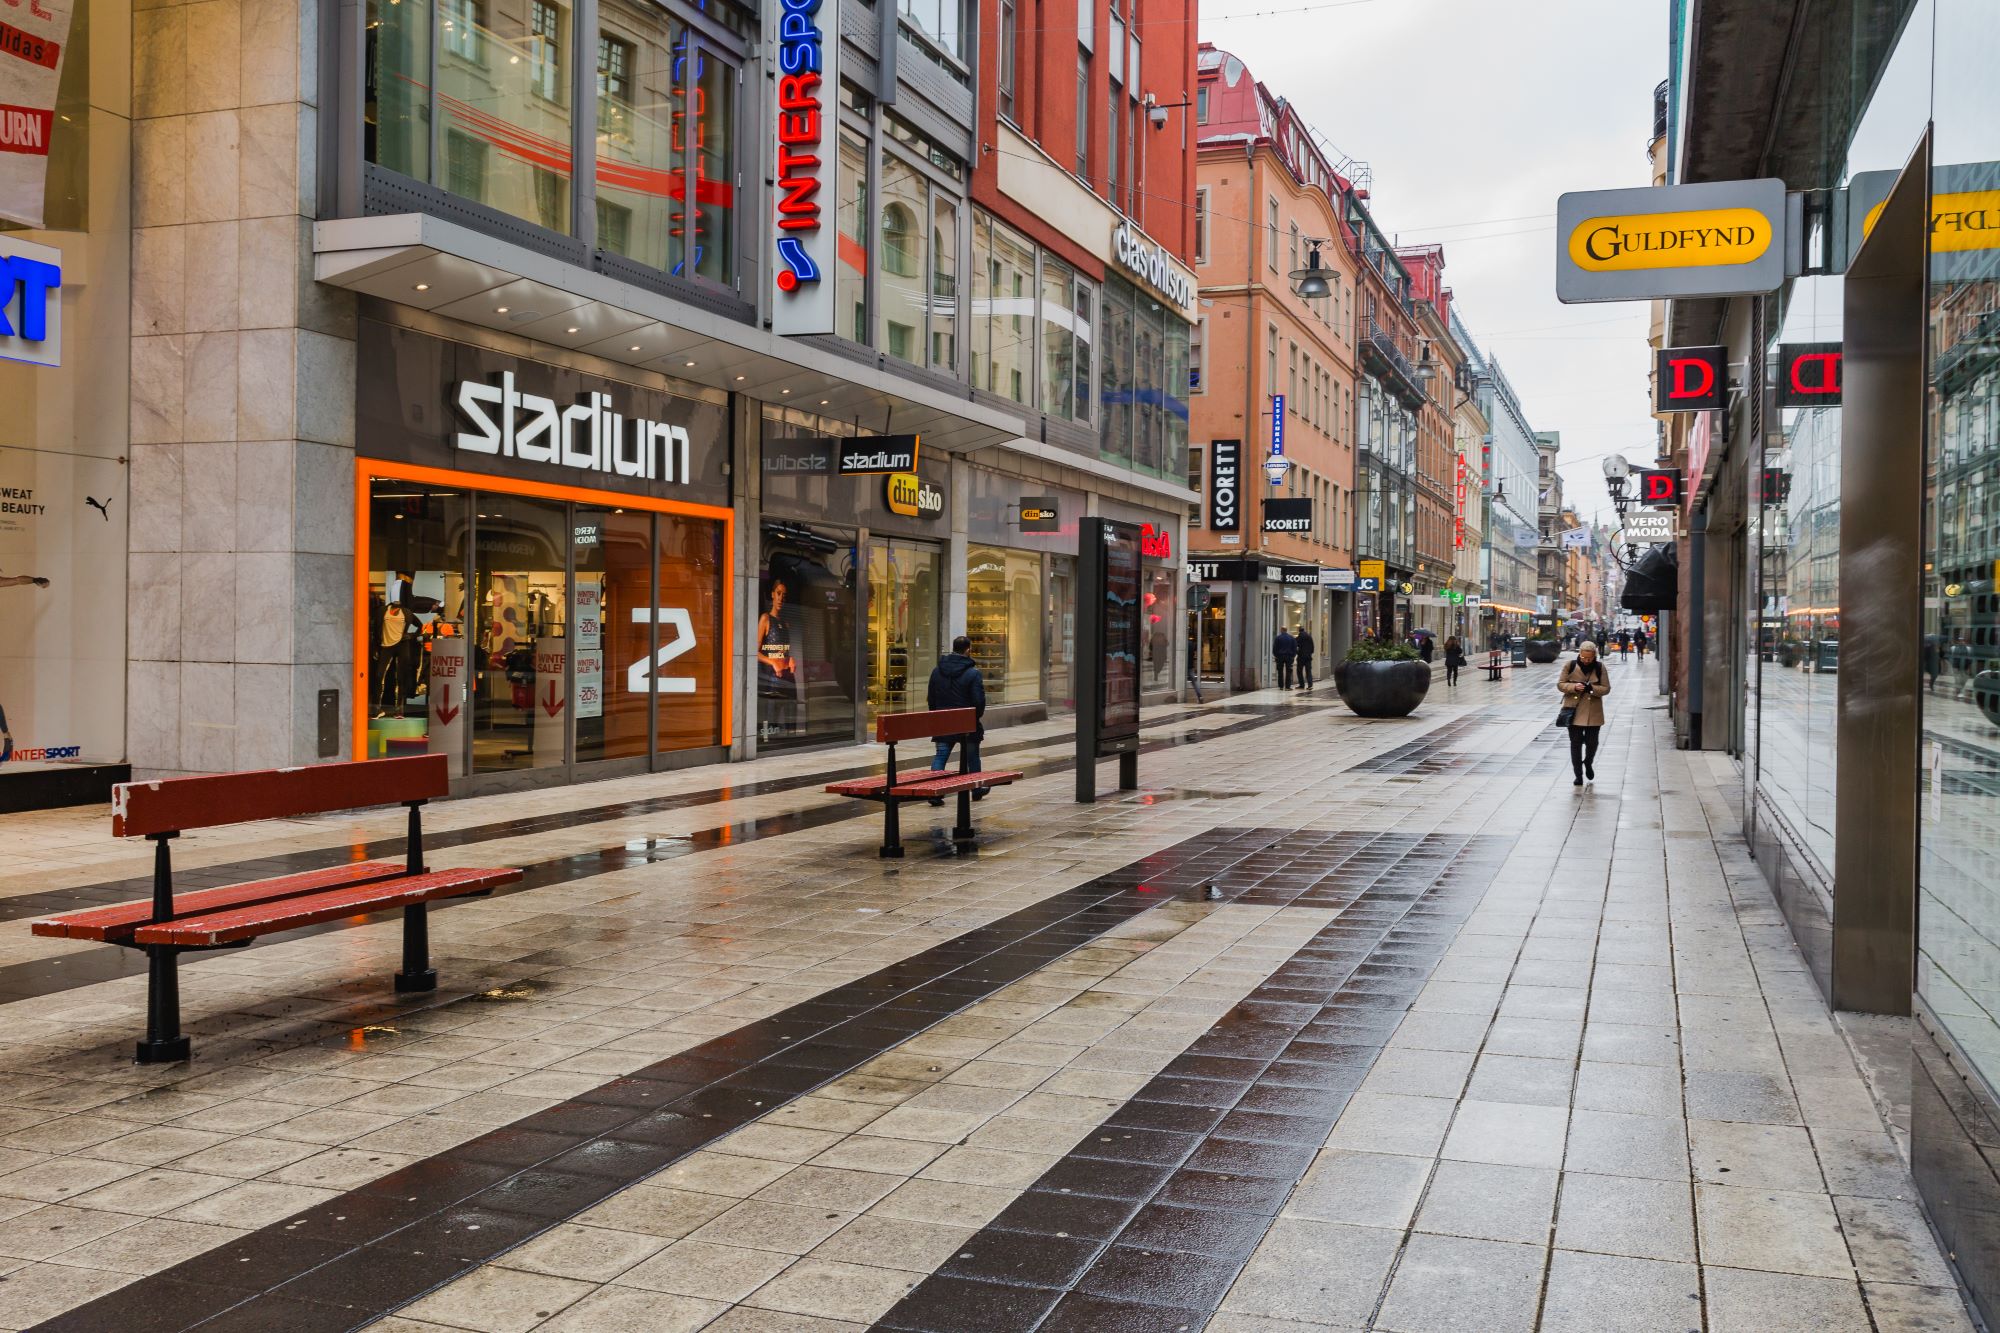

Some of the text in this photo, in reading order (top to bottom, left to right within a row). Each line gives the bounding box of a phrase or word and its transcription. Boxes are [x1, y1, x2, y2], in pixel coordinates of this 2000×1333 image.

[1585, 224, 1755, 261] GULDFYND
[1114, 218, 1189, 310] clas ohlson
[457, 371, 690, 484] stadium
[842, 451, 910, 470] stadium
[1215, 443, 1235, 527] SCORETT
[1455, 452, 1467, 550] APOTEK
[2, 502, 45, 515] BEAUTY
[1265, 519, 1310, 530] SCORETT
[1629, 516, 1669, 527] VERO
[1626, 527, 1670, 537] MODA
[1285, 574, 1318, 583] SCORETT
[1357, 578, 1373, 590] JC
[538, 663, 562, 673] SALE!
[577, 659, 595, 667] WINTER
[432, 667, 456, 677] SALE!
[11, 746, 80, 762] INTERSPORT
